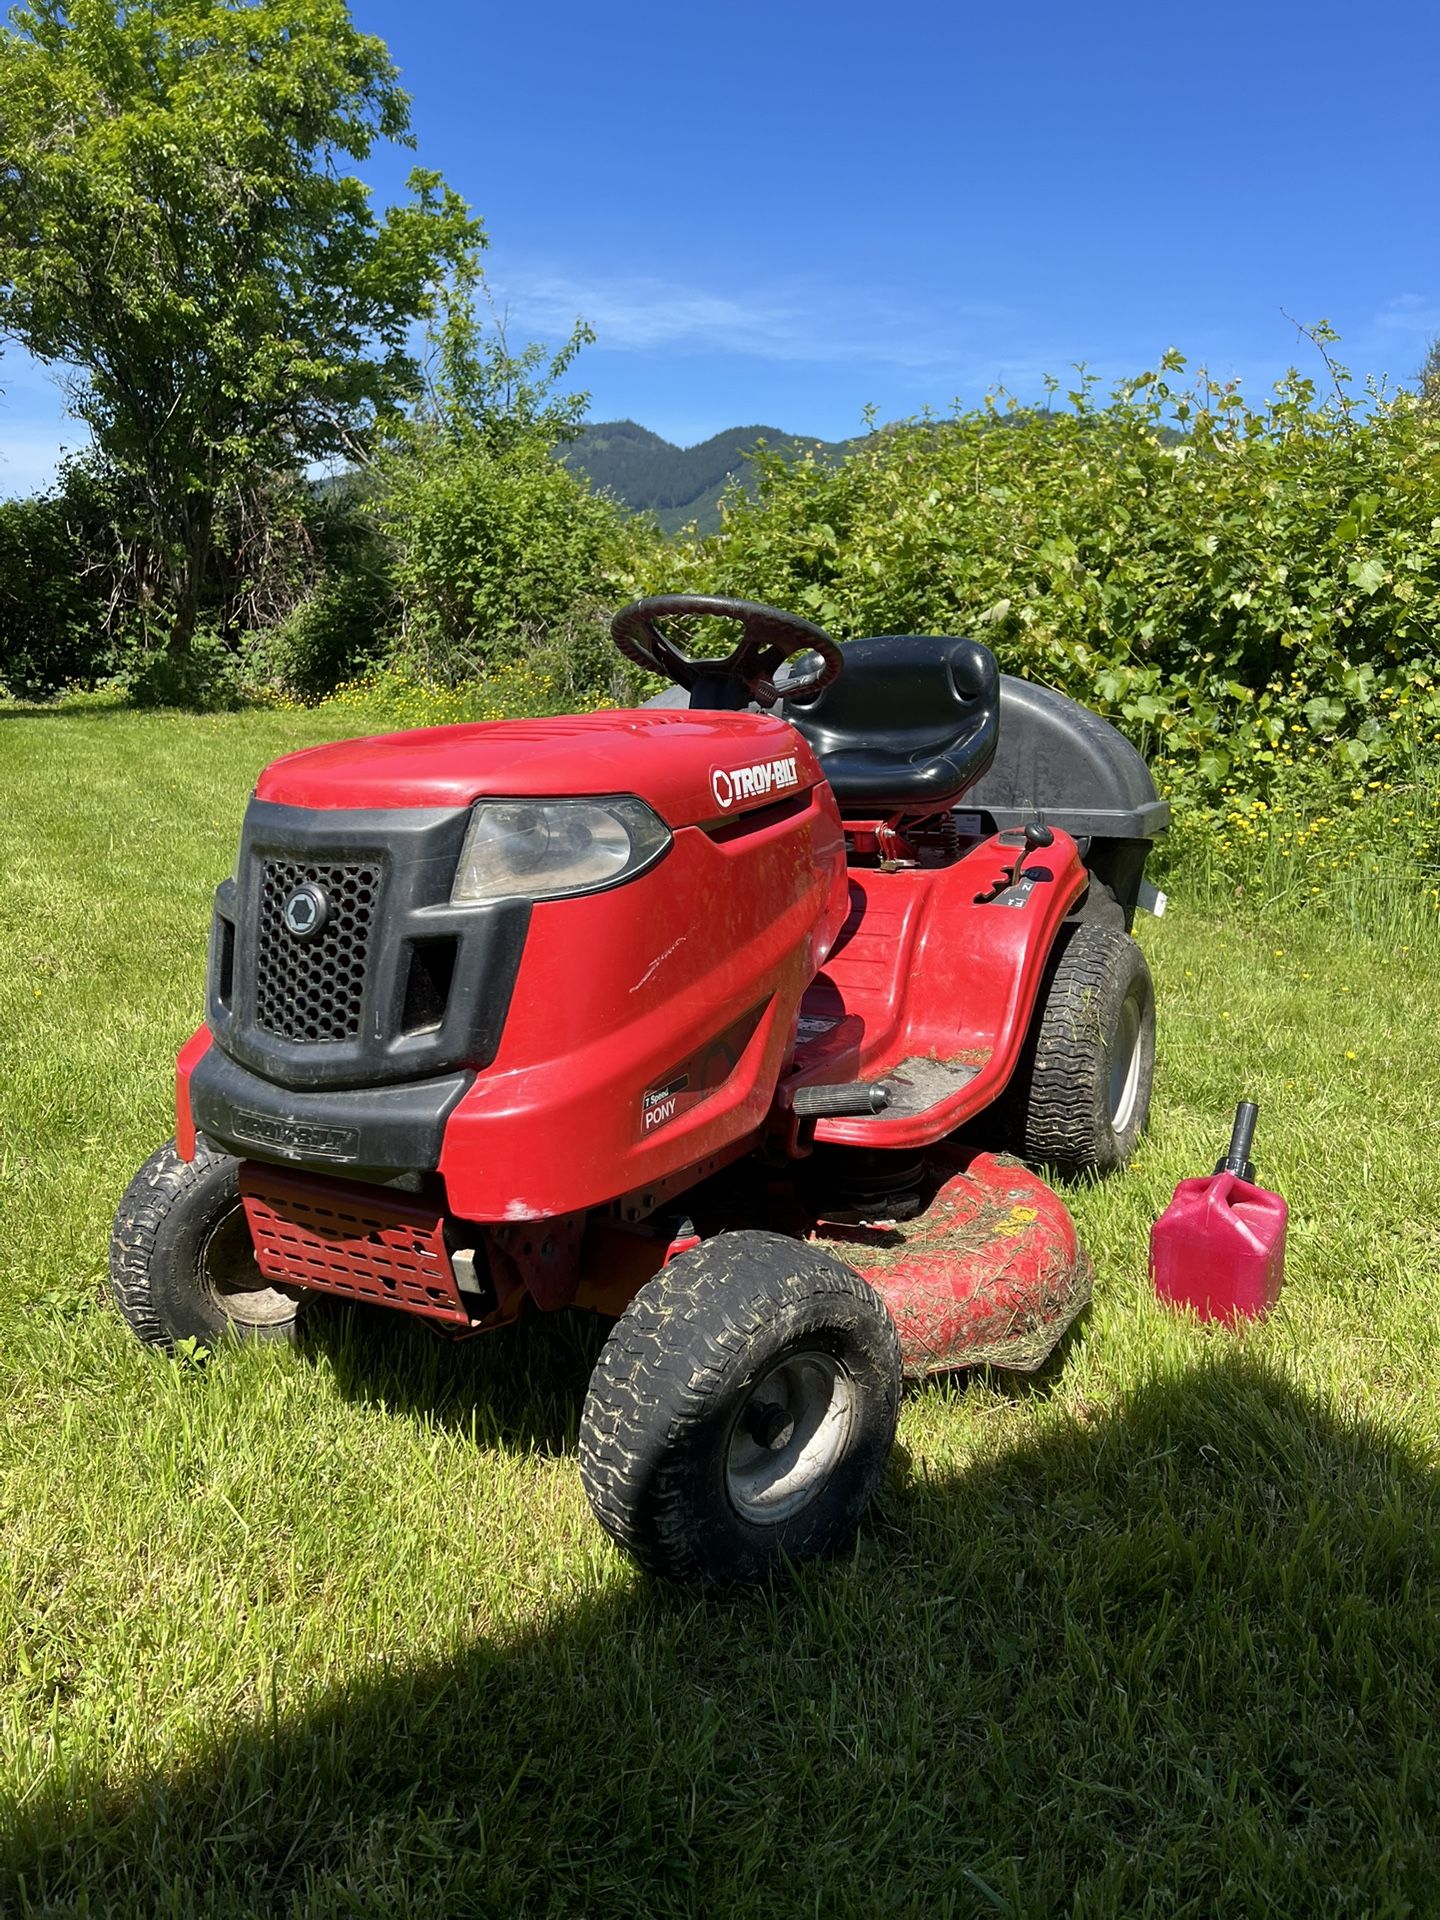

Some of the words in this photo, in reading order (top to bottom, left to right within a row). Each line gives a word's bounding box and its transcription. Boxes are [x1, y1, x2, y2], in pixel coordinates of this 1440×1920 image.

[730, 758, 798, 800] TROY-BILT
[650, 1087, 669, 1104] Speed
[645, 1098, 676, 1129] PONY
